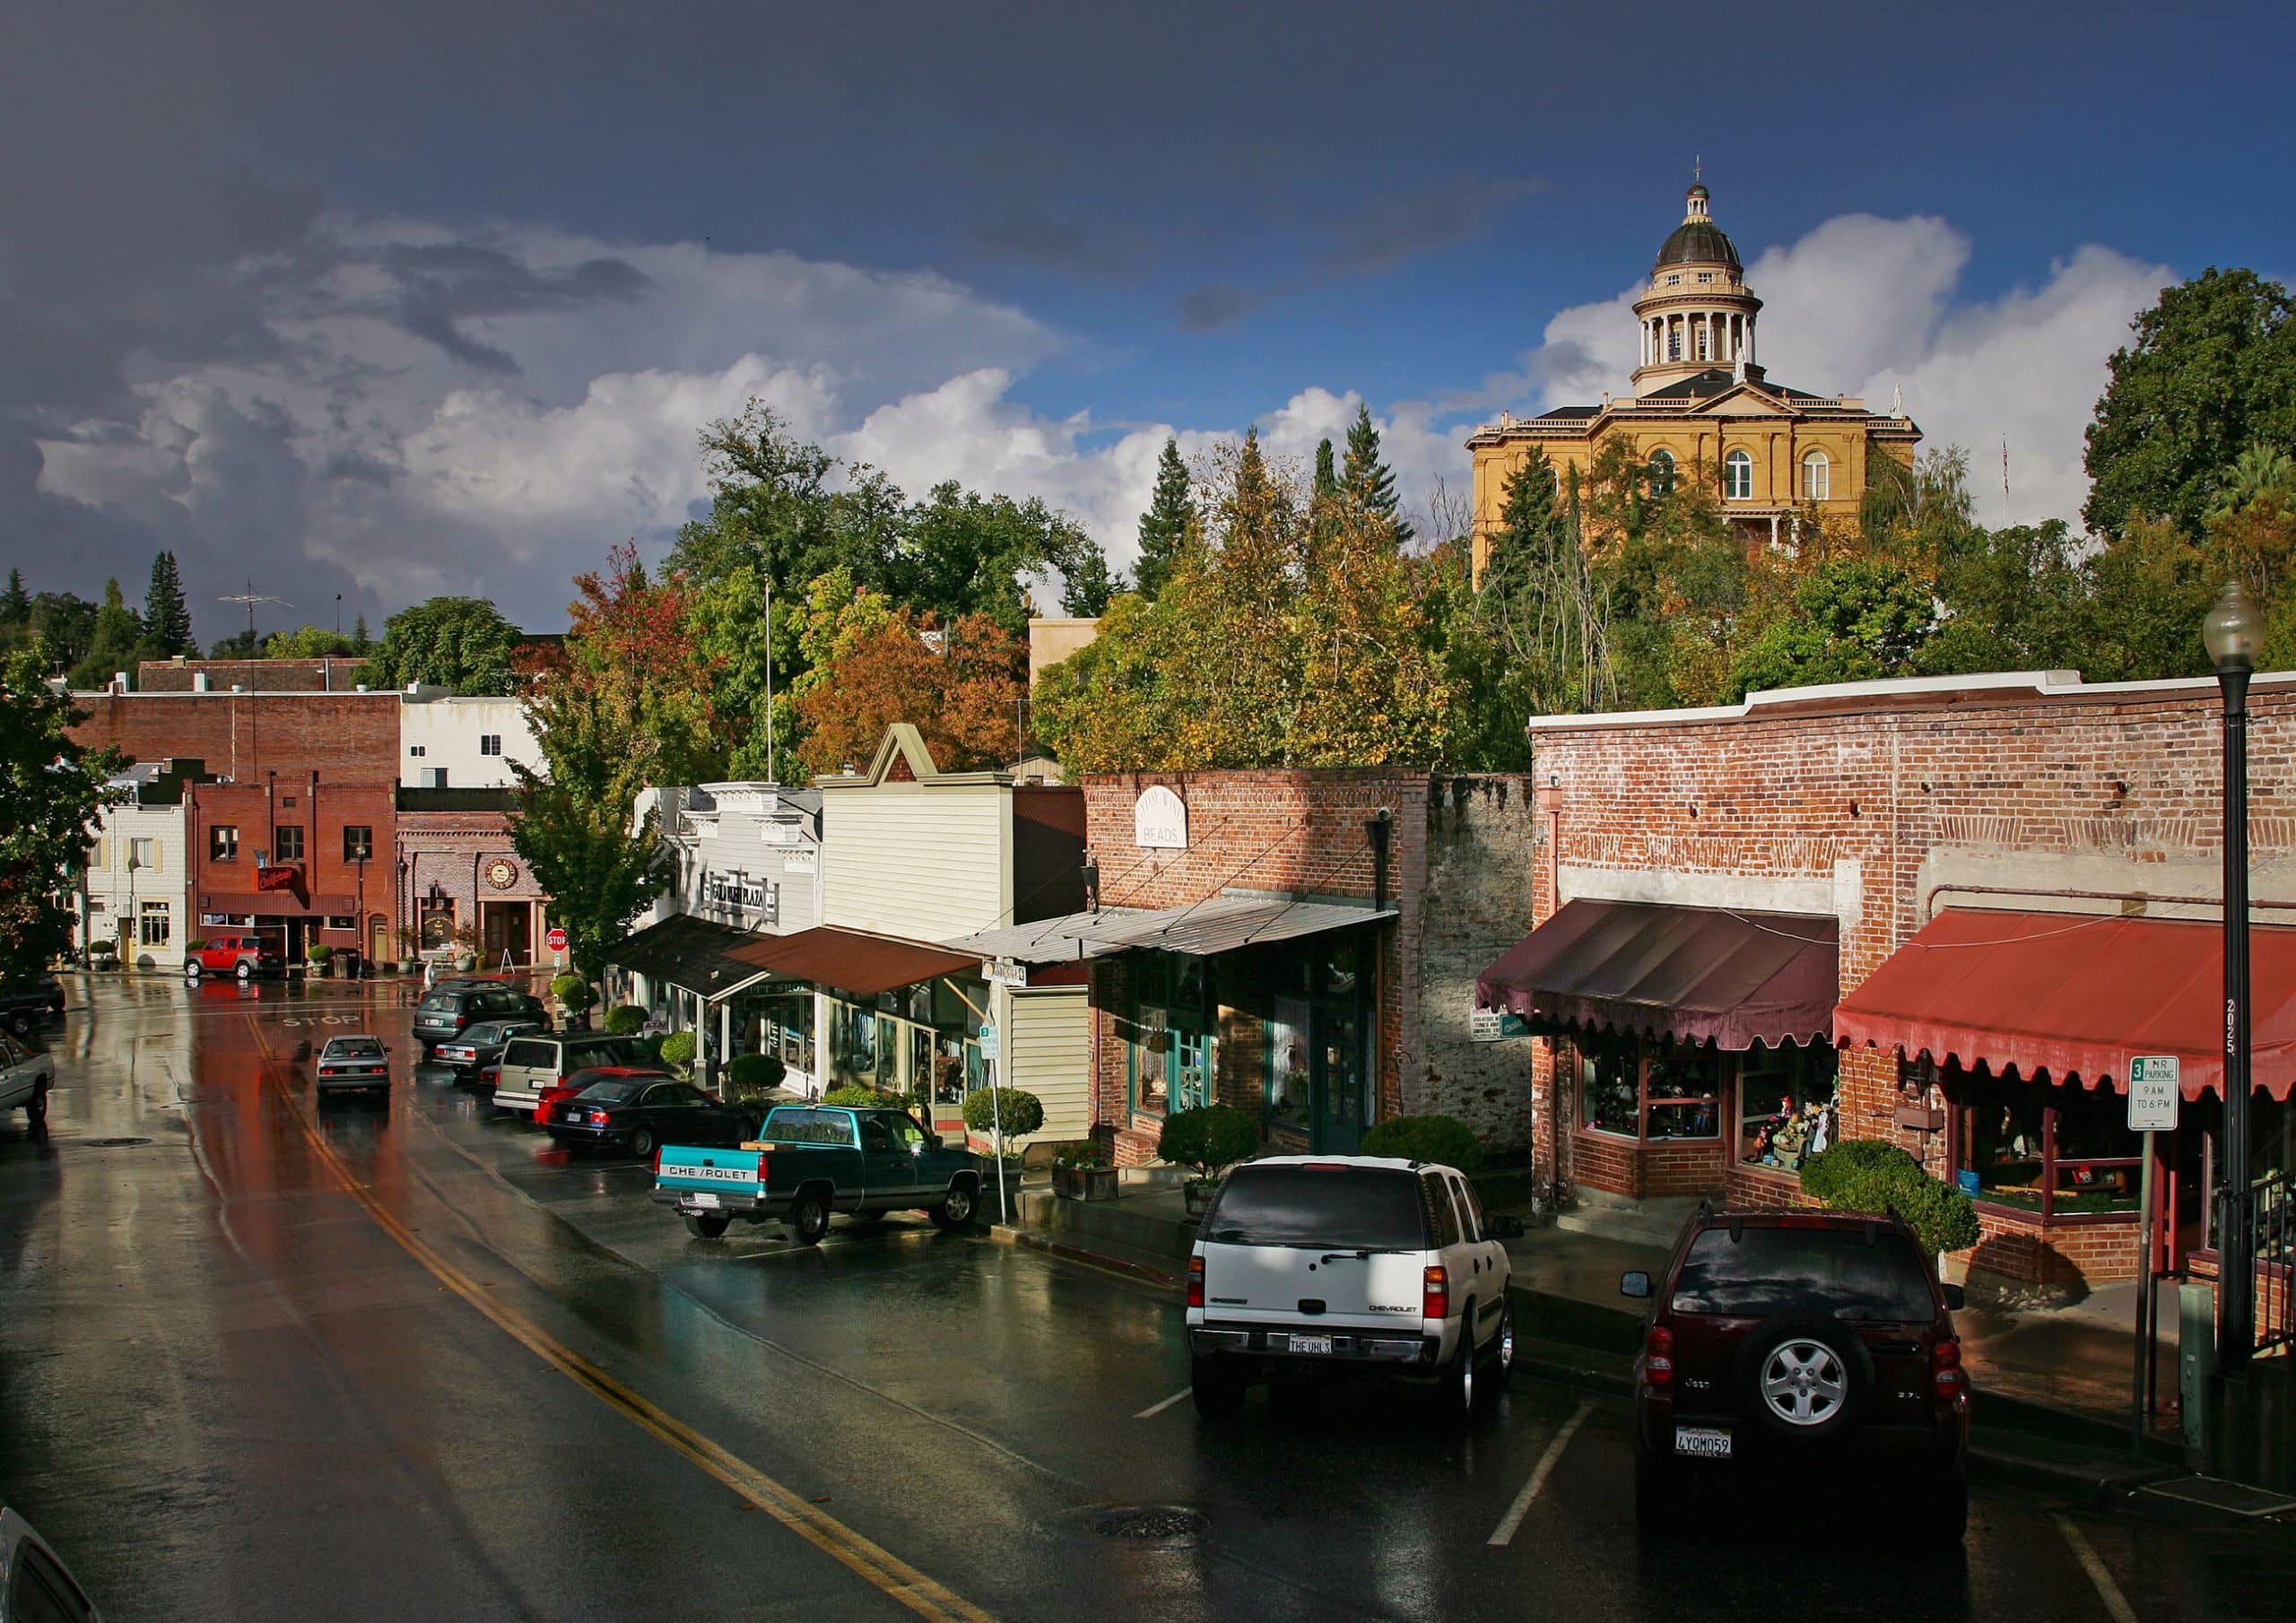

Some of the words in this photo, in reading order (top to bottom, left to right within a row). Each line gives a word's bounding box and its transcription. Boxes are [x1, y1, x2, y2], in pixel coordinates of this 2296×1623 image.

[1144, 827, 1178, 843] BEADS
[712, 884, 726, 902] GOLD
[743, 887, 762, 907] PLAZA
[548, 935, 567, 945] STOP
[283, 1016, 360, 1027] STOP
[2227, 999, 2235, 1054] 2025
[2134, 1063, 2143, 1078] 3
[2144, 1070, 2174, 1079] PARKING
[2144, 1086, 2149, 1094] 9
[2152, 1086, 2164, 1095] AM
[2137, 1099, 2147, 1109] TO
[2149, 1099, 2155, 1109] 6
[2157, 1099, 2170, 1109] PM
[669, 1167, 748, 1180] CHEVROLET
